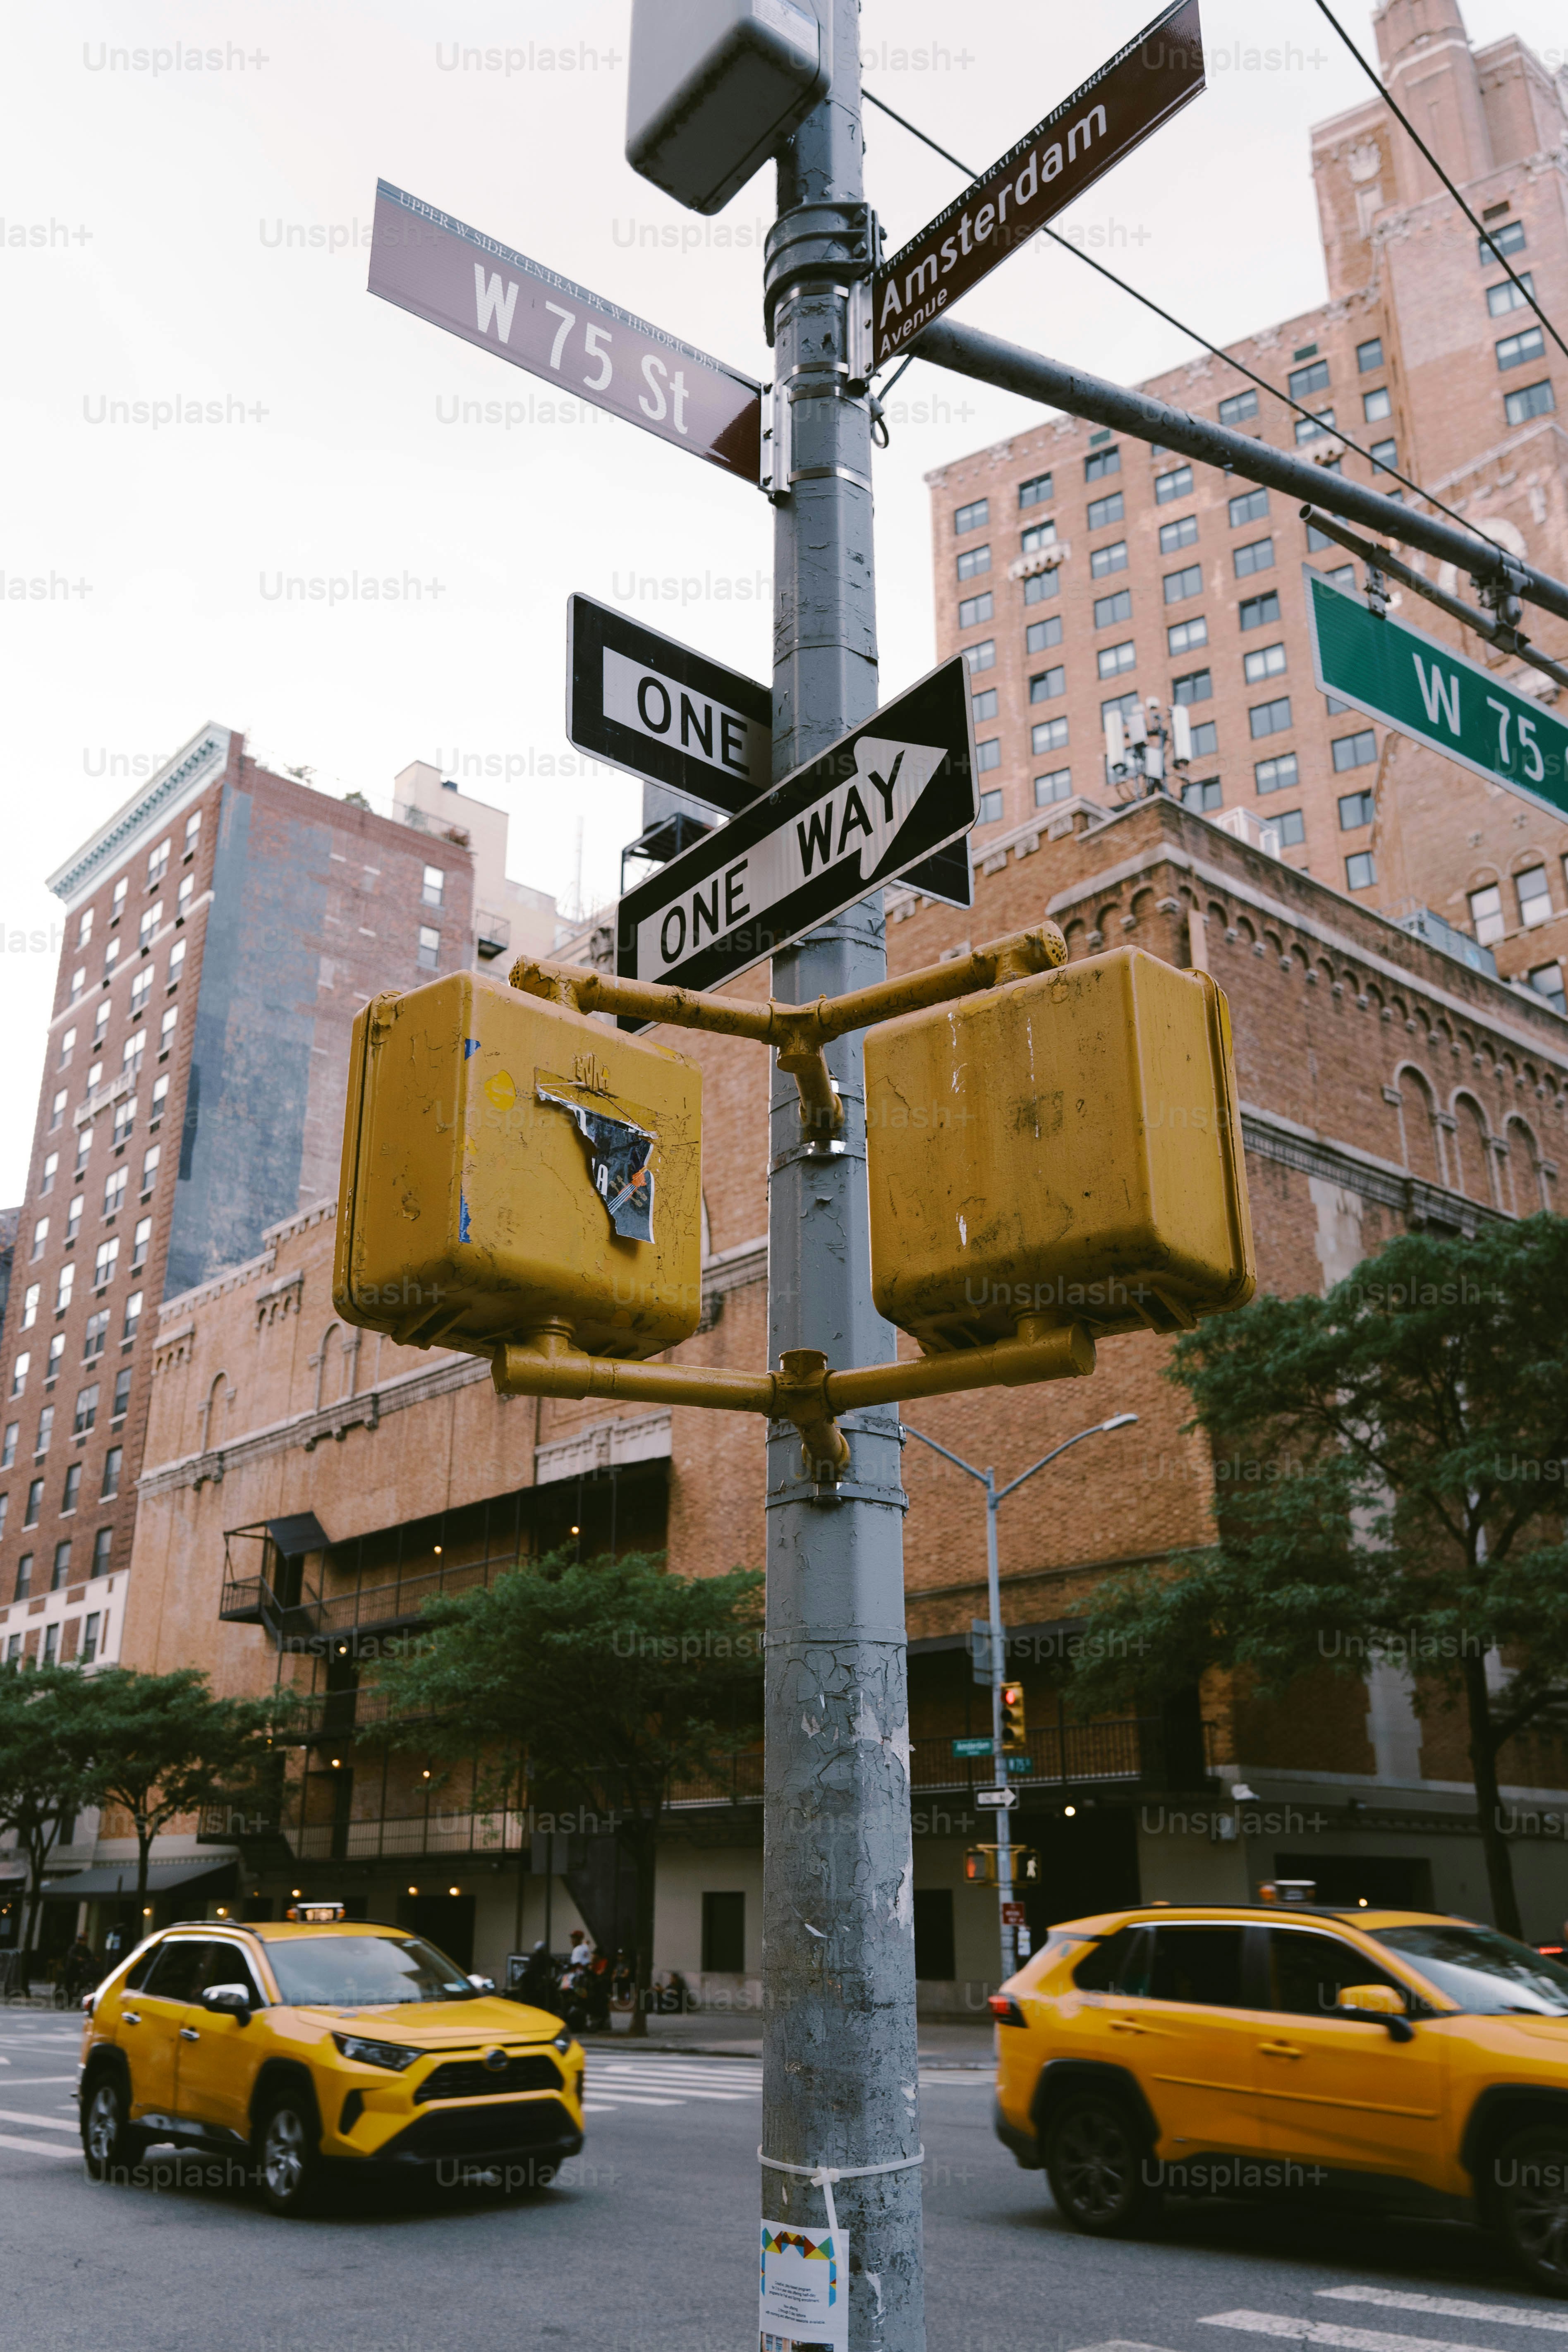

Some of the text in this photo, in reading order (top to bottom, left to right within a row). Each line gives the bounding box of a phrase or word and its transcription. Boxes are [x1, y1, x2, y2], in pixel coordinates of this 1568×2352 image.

[879, 242, 914, 278] UPPER
[916, 232, 926, 243] W
[1015, 136, 1032, 156] PK
[1034, 121, 1046, 136] W
[1049, 62, 1111, 125] HISTORIC
[879, 103, 1107, 330] Amsterdam
[400, 193, 722, 373] UPPER W SIDE/CENTRAL PK W HISTORIC DIST
[474, 262, 689, 434] W 75 St
[879, 287, 948, 359] Avenue
[637, 676, 750, 777] ONE
[1412, 652, 1461, 737] W
[1487, 696, 1544, 782] 75
[661, 749, 906, 964] ONE WAY
